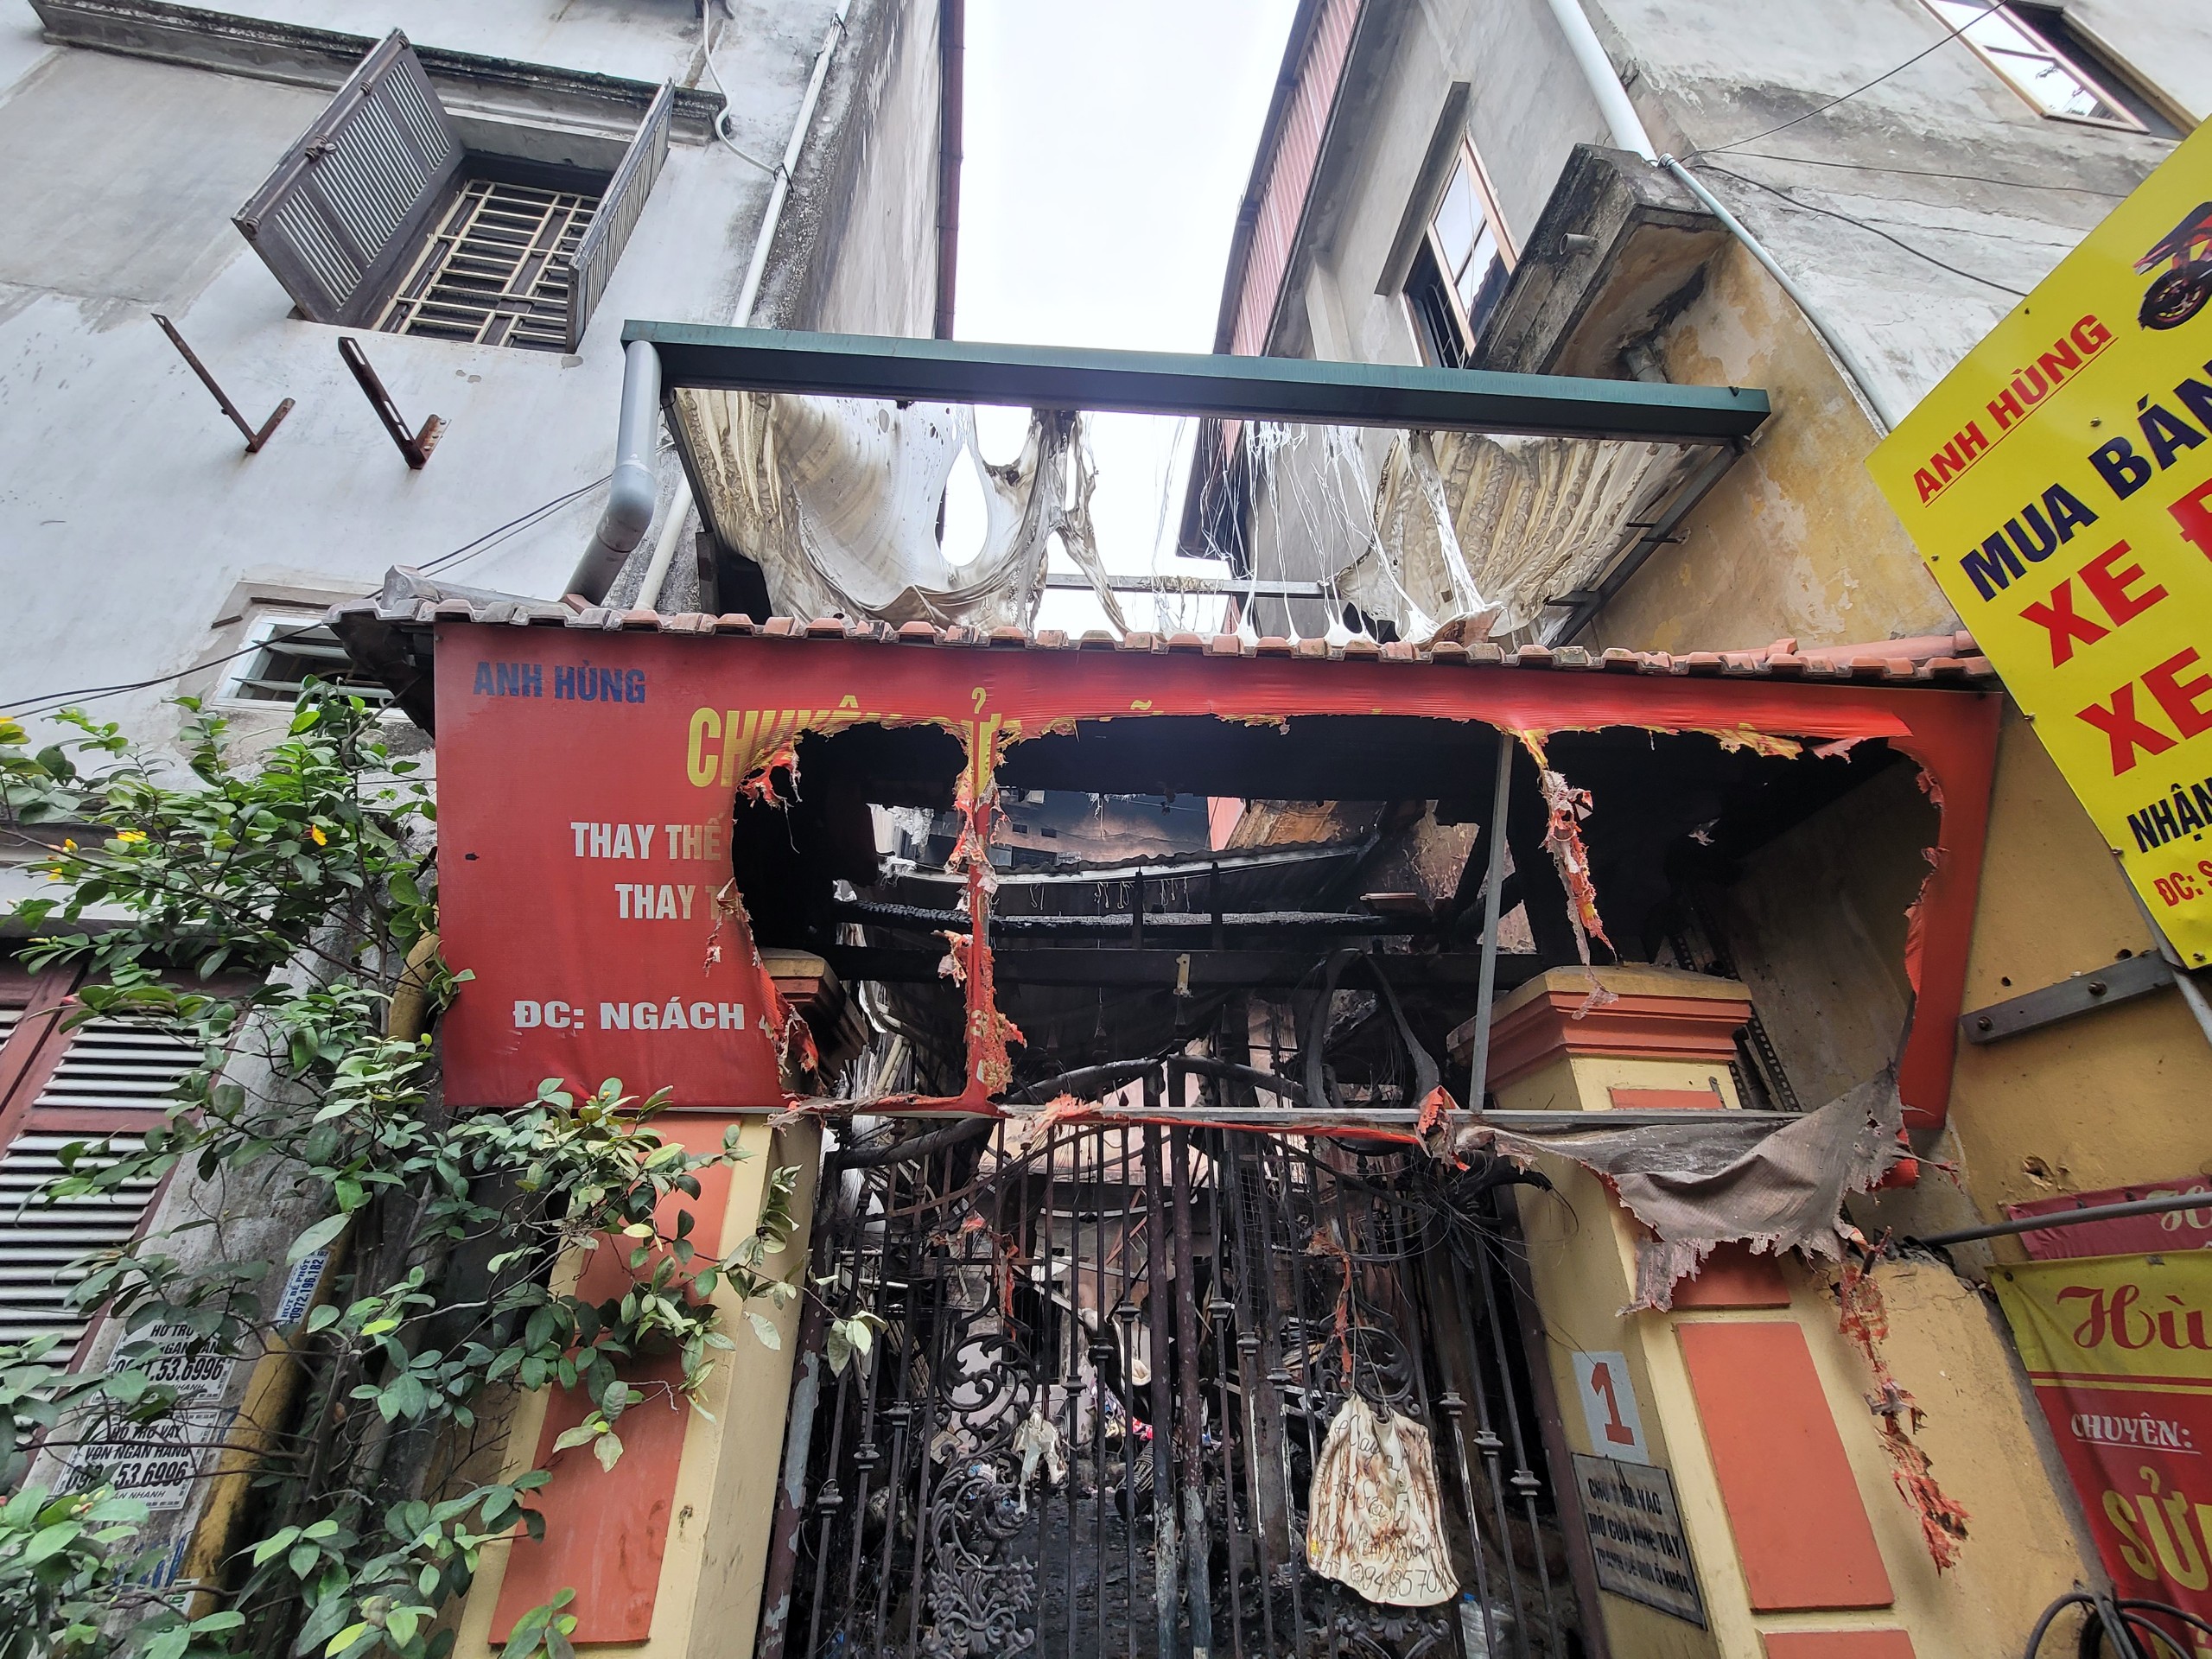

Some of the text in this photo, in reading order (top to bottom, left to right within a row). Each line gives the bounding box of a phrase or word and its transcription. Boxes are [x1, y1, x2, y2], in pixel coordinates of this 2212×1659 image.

[1913, 314, 2113, 504] ANH HÙNG
[1959, 482, 2100, 602] MUA
[2018, 538, 2170, 669] XE
[474, 659, 645, 703] ANH HÙNG
[2075, 645, 2212, 777] XE
[570, 812, 722, 861] THAY THẾ
[615, 884, 696, 920] THAY
[2153, 872, 2204, 907] ĐC:
[512, 1000, 584, 1029] ĐC:
[601, 996, 746, 1030] NGÁCH
[289, 1259, 324, 1319] 0972.196.182
[1591, 1362, 1636, 1446] 1
[2071, 1412, 2192, 1449] CHUYÊN:
[1657, 1531, 1681, 1560] TAY
[2102, 1466, 2212, 1592] SỬ
